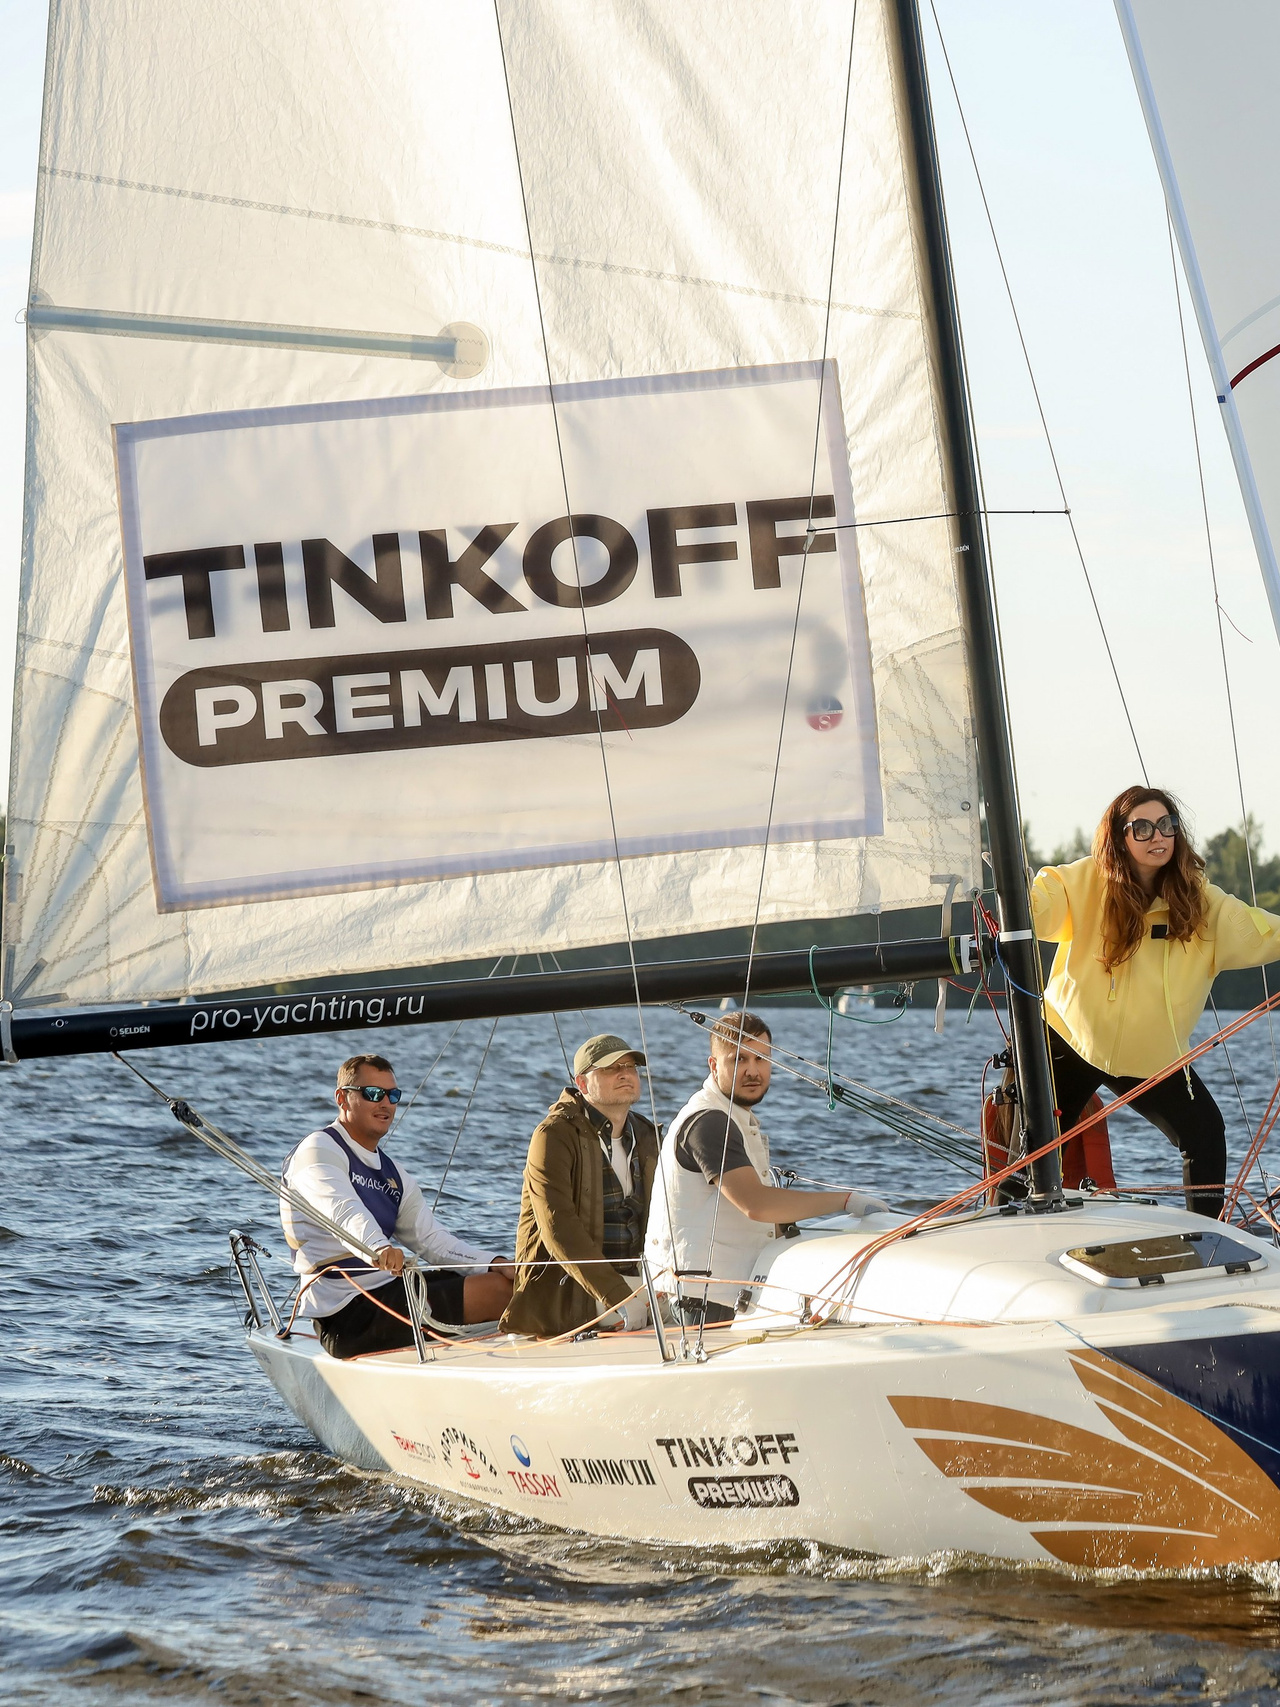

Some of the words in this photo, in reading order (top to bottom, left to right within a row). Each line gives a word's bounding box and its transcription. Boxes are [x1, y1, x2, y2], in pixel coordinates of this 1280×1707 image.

[144, 495, 838, 640] TINKOFF
[195, 648, 665, 746] PREMIUM
[190, 995, 425, 1036] pro-yachting.ru
[656, 1433, 800, 1468] TINKOFF
[507, 1470, 563, 1498] TASSAY
[560, 1457, 657, 1488] ВЕДОМОСТИ
[693, 1479, 796, 1504] PREMIUM
